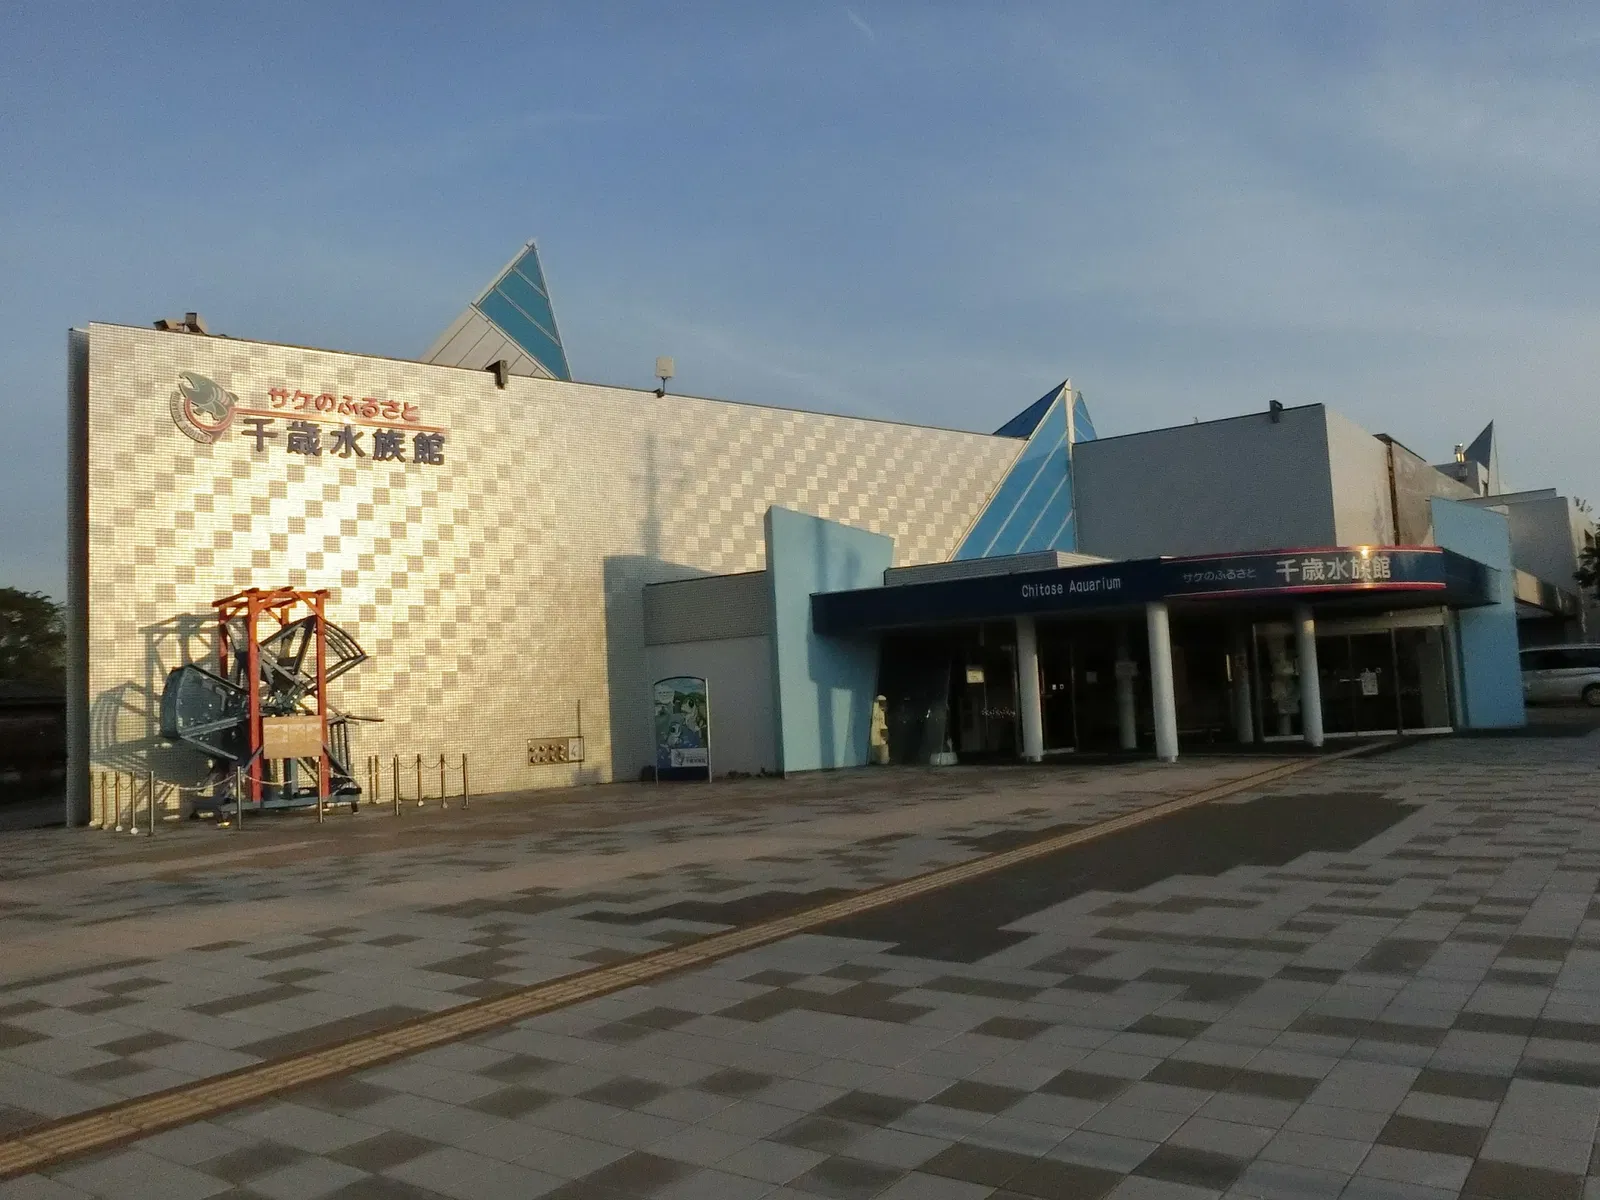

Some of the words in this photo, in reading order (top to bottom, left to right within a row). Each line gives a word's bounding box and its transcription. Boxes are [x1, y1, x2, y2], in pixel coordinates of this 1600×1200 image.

[268, 387, 419, 421] サケのふるさと
[241, 418, 446, 465] 千歳水族館
[1182, 567, 1256, 584] サケのふるさと
[1275, 556, 1391, 583] 千歳水族館
[1021, 583, 1064, 598] Chitose
[1069, 575, 1122, 596] Aquarium
